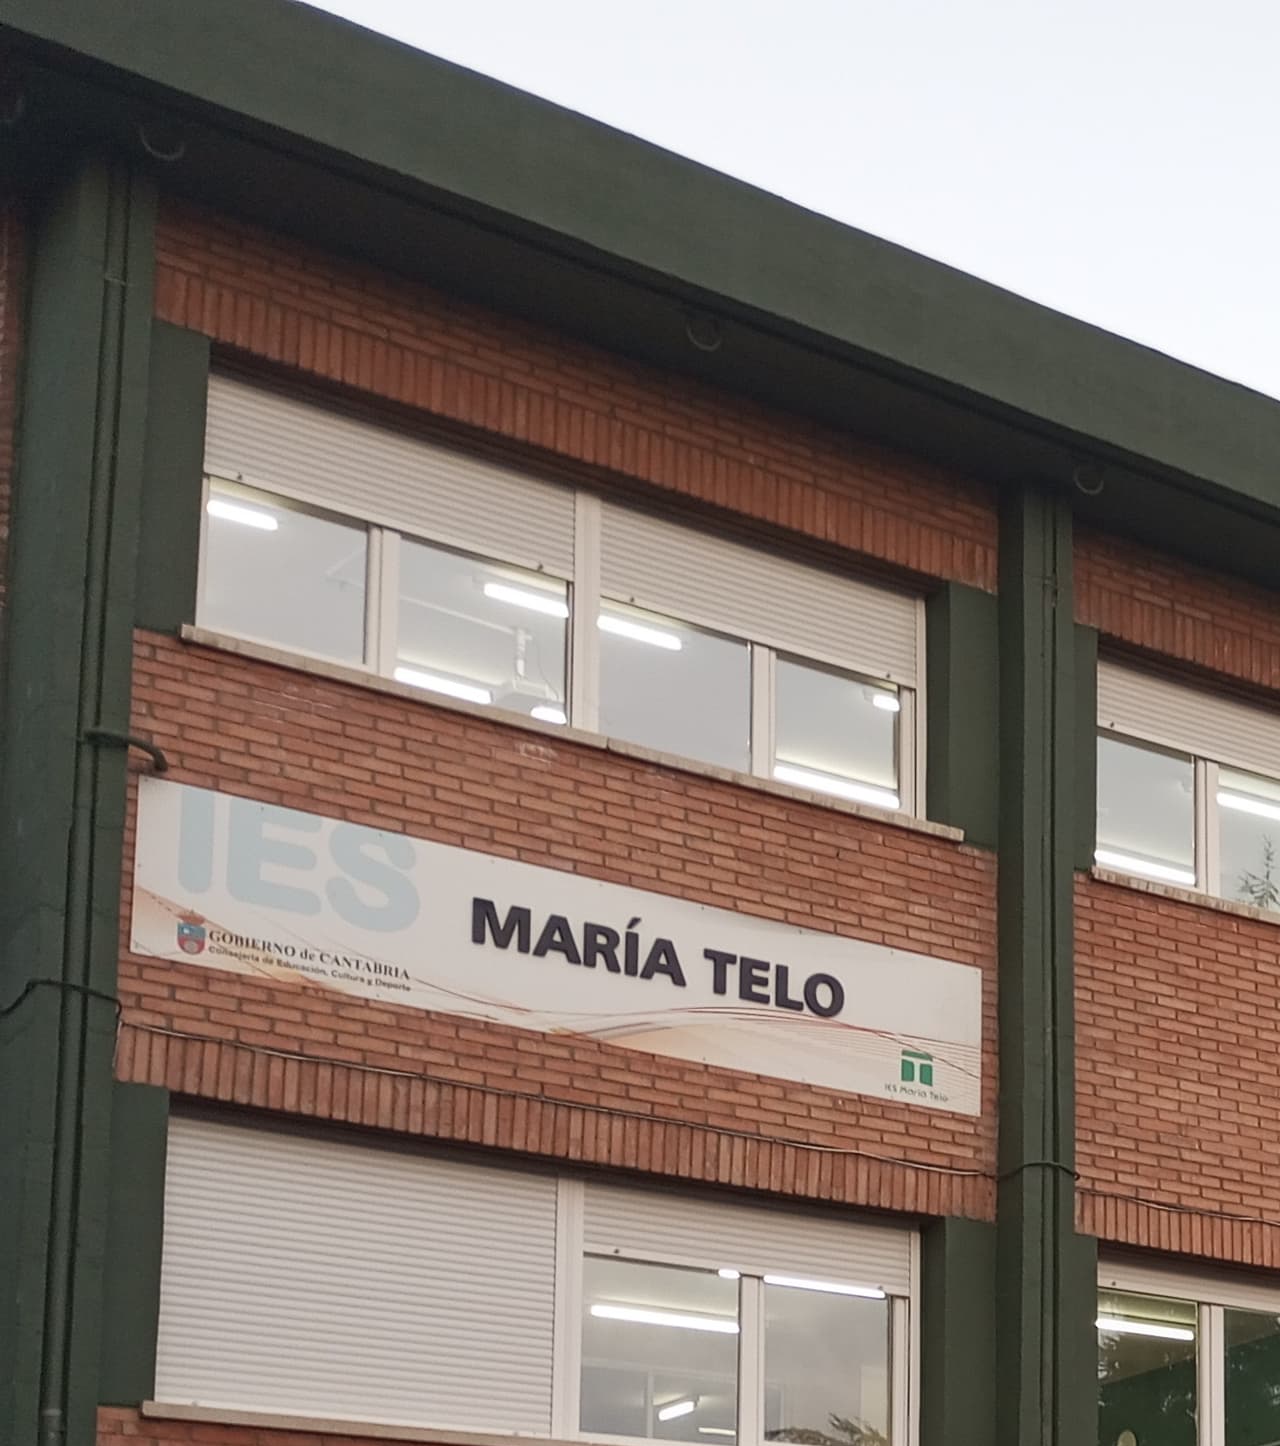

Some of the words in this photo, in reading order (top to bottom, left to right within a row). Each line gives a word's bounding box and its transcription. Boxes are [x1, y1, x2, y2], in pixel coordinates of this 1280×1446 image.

[177, 786, 421, 934] IES
[209, 930, 296, 957] GOBIERNO
[300, 948, 316, 961] de
[319, 952, 410, 980] CANTABRIA
[471, 897, 687, 988] MARÍA
[703, 948, 845, 1018] TELO
